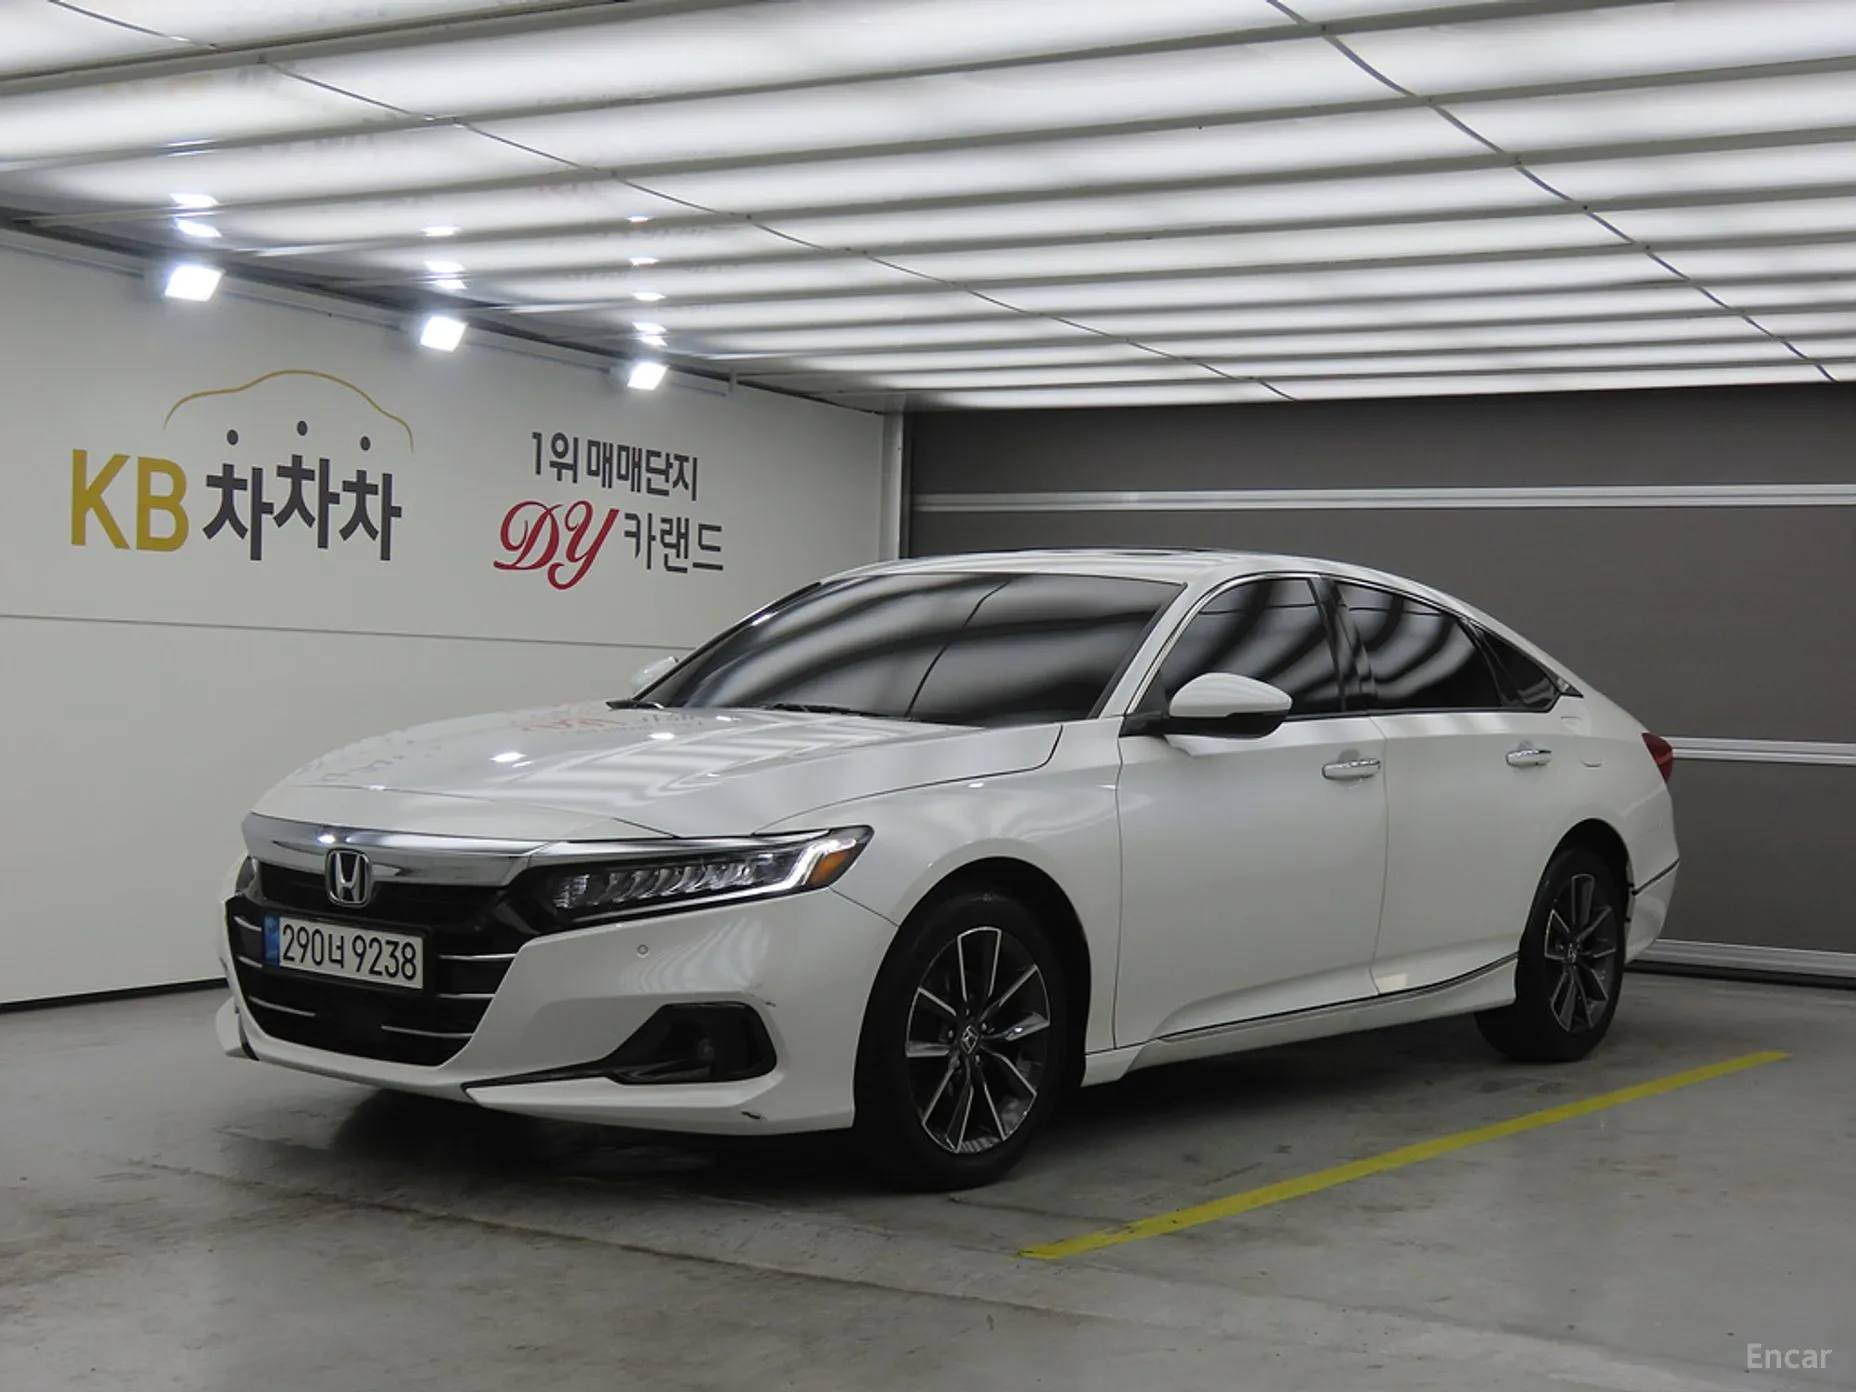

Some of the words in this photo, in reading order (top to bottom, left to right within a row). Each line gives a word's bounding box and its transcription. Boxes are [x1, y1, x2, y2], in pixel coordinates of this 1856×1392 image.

[71, 448, 190, 552] KB
[202, 420, 402, 561] 차차차
[531, 431, 579, 484] 1위
[586, 439, 698, 502] 매매단지
[493, 500, 620, 590] DY
[624, 512, 724, 574] 카랜드
[282, 924, 344, 969] 290너
[352, 934, 416, 981] 9238
